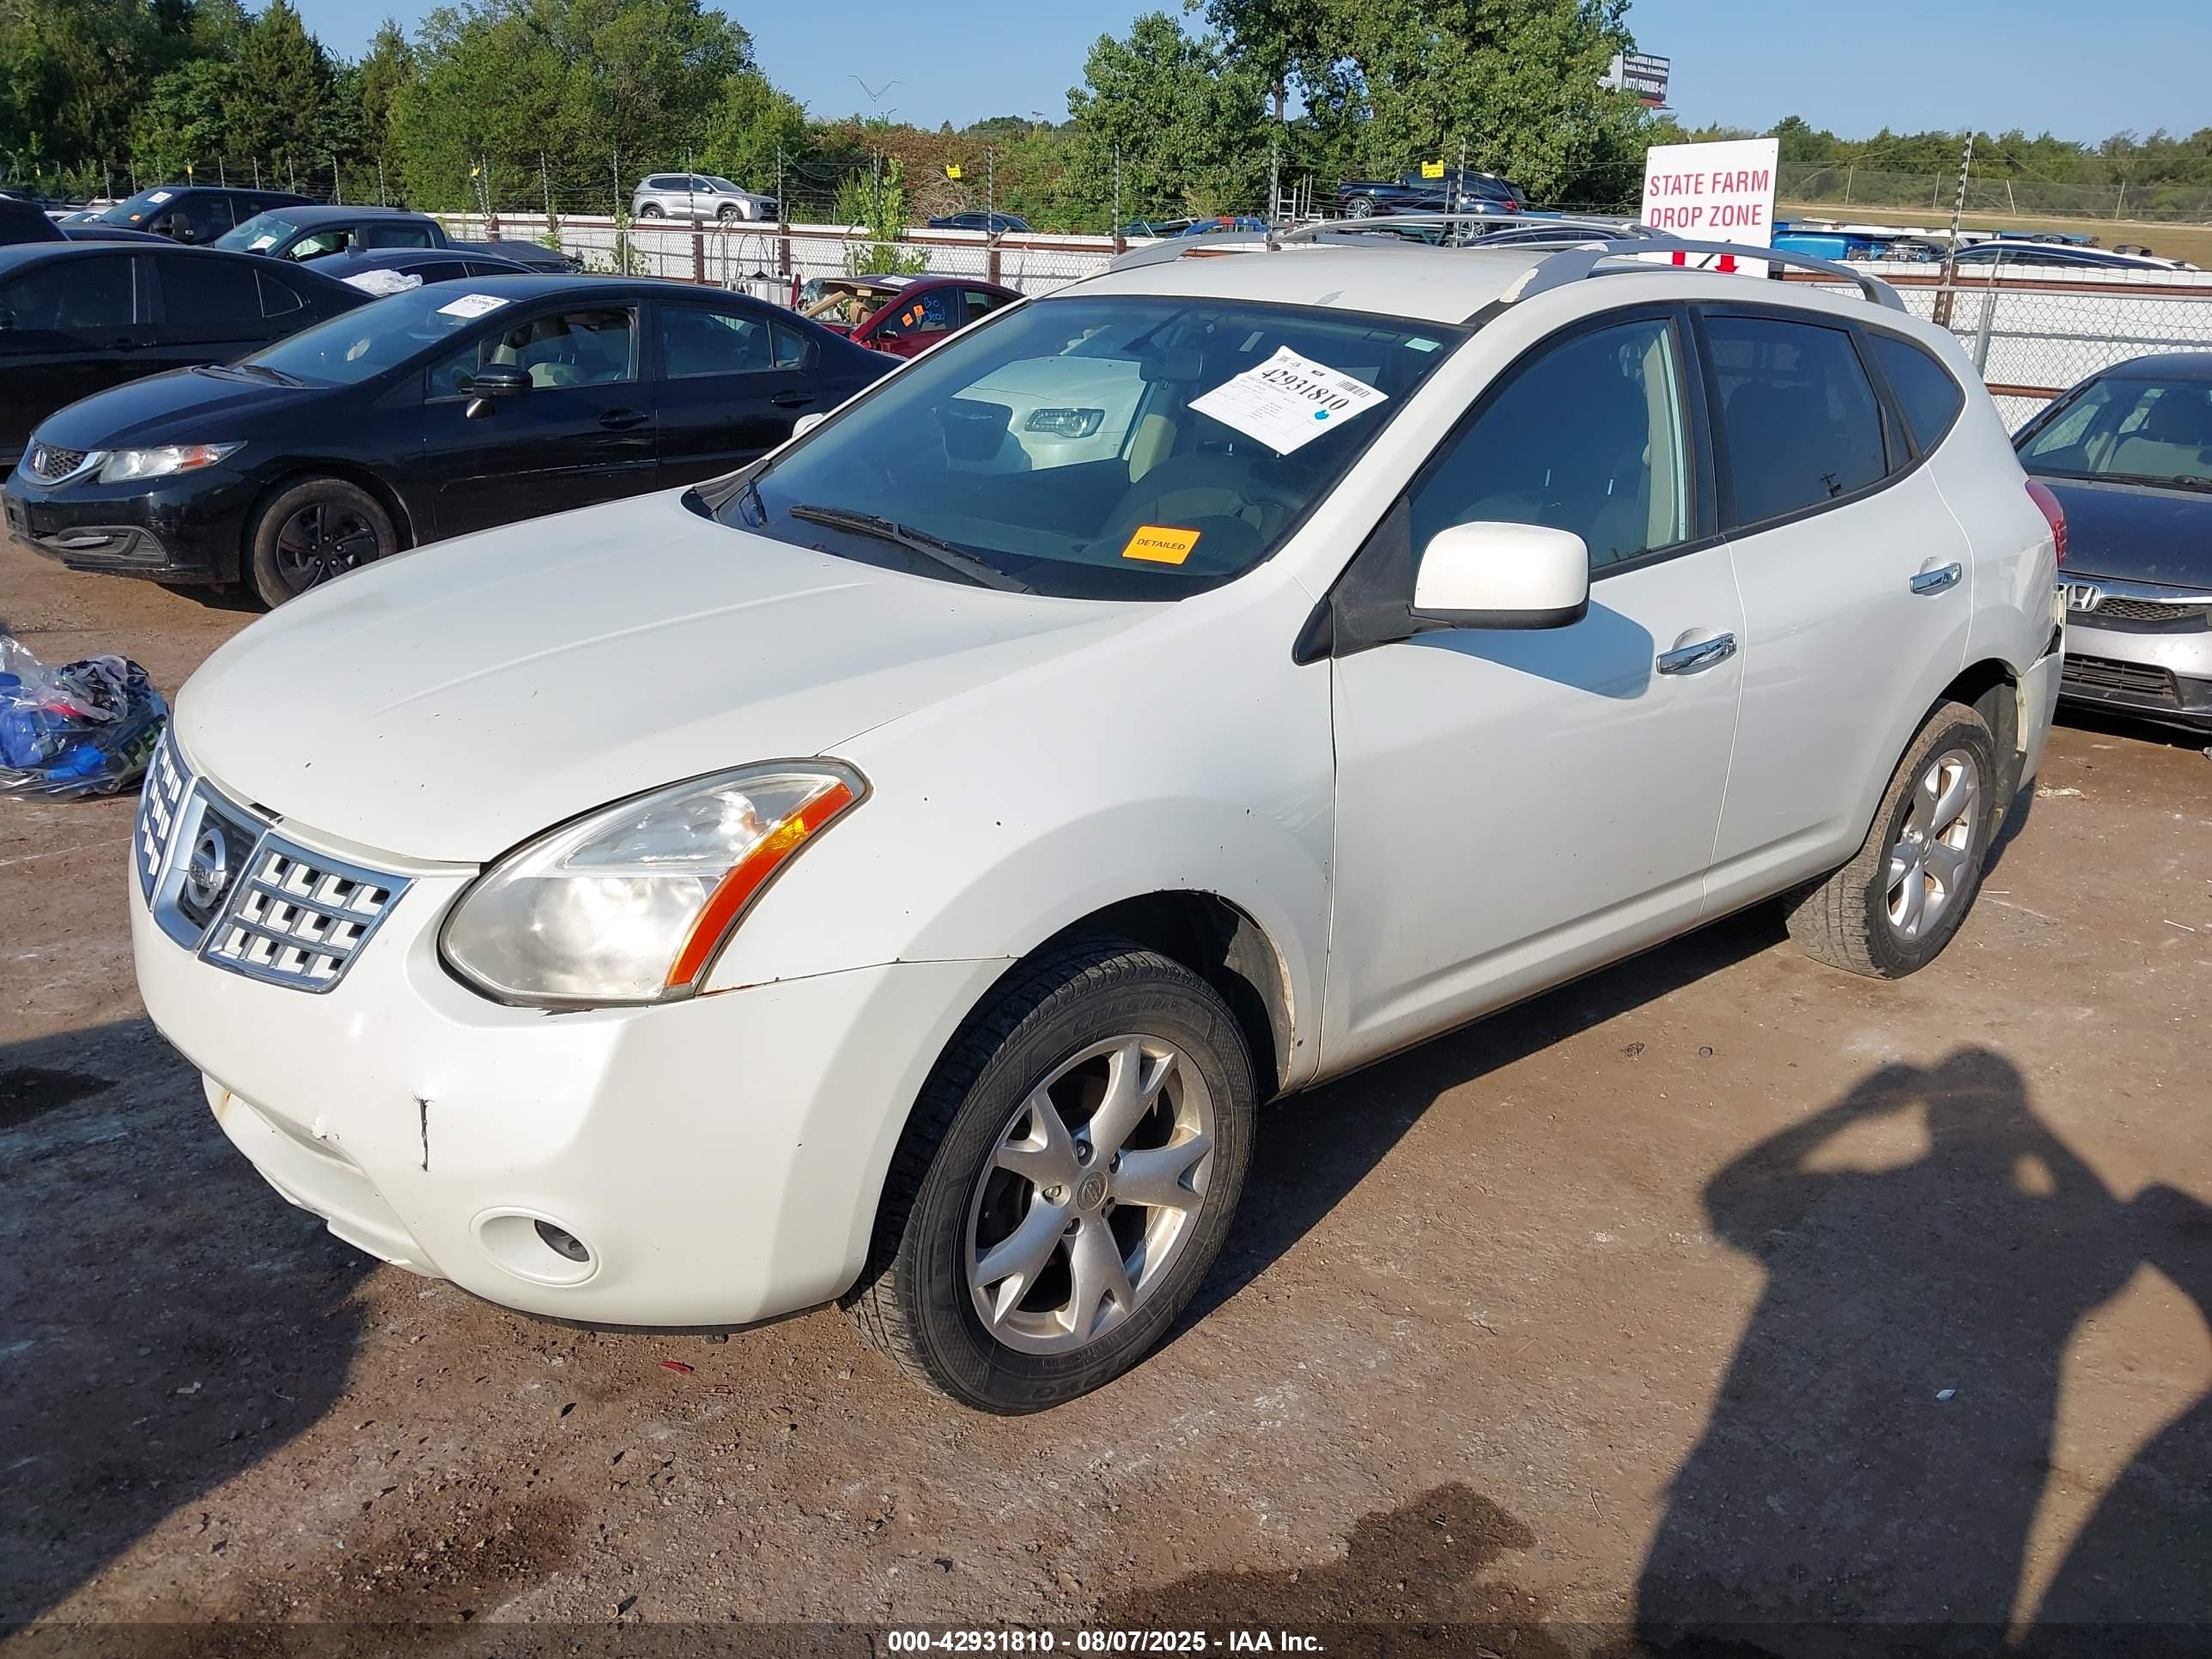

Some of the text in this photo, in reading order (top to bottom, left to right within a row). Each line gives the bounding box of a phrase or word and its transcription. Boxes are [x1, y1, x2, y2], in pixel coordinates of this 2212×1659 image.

[1650, 170, 1770, 197] STATE FARM
[1650, 204, 1763, 229] DROP ZONE
[1261, 368, 1349, 410] 42931810
[1136, 538, 1186, 550] DETAILED
